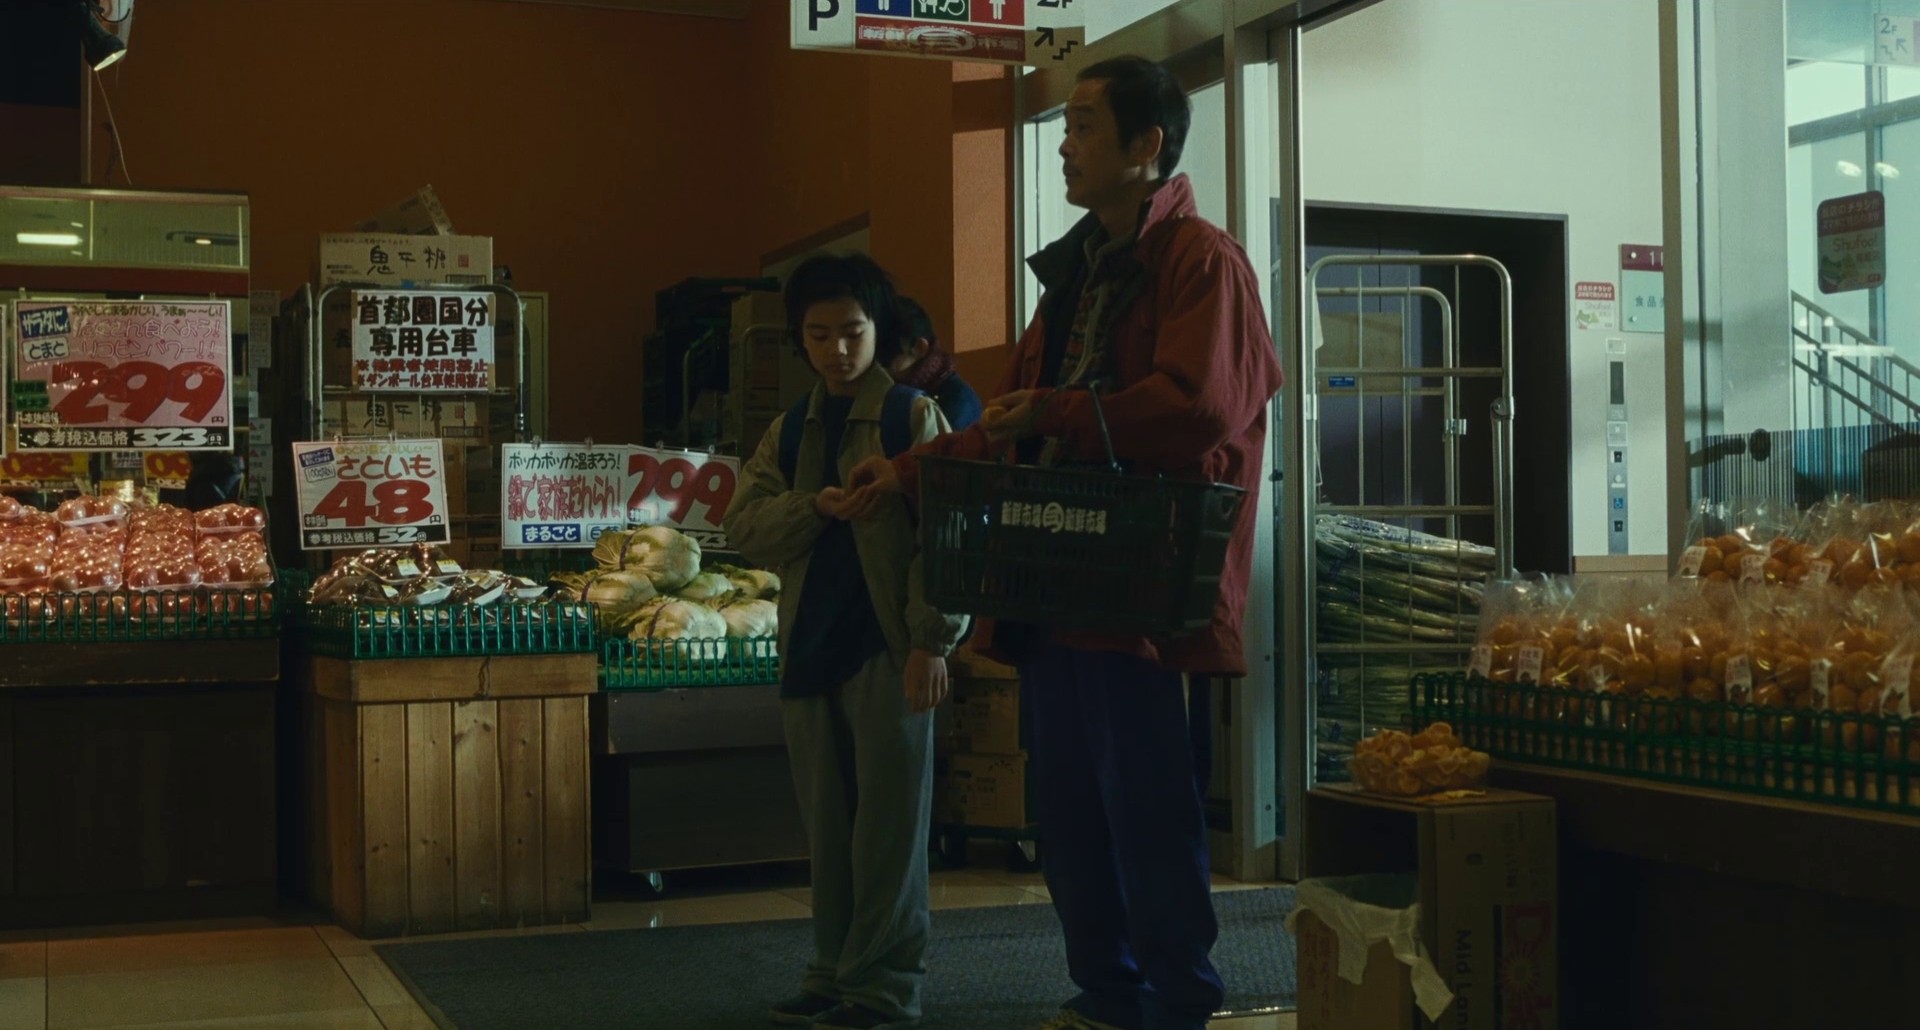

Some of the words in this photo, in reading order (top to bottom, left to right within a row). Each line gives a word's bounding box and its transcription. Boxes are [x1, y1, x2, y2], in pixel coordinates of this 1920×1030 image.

[357, 295, 489, 325] 首都圏国分
[29, 341, 66, 359] とまと
[369, 327, 478, 357] 専用台車
[52, 361, 225, 423] 299
[336, 454, 437, 480] さといも
[312, 479, 434, 527] 48
[525, 526, 578, 541] まるごと
[1456, 981, 1473, 1030] Lan
